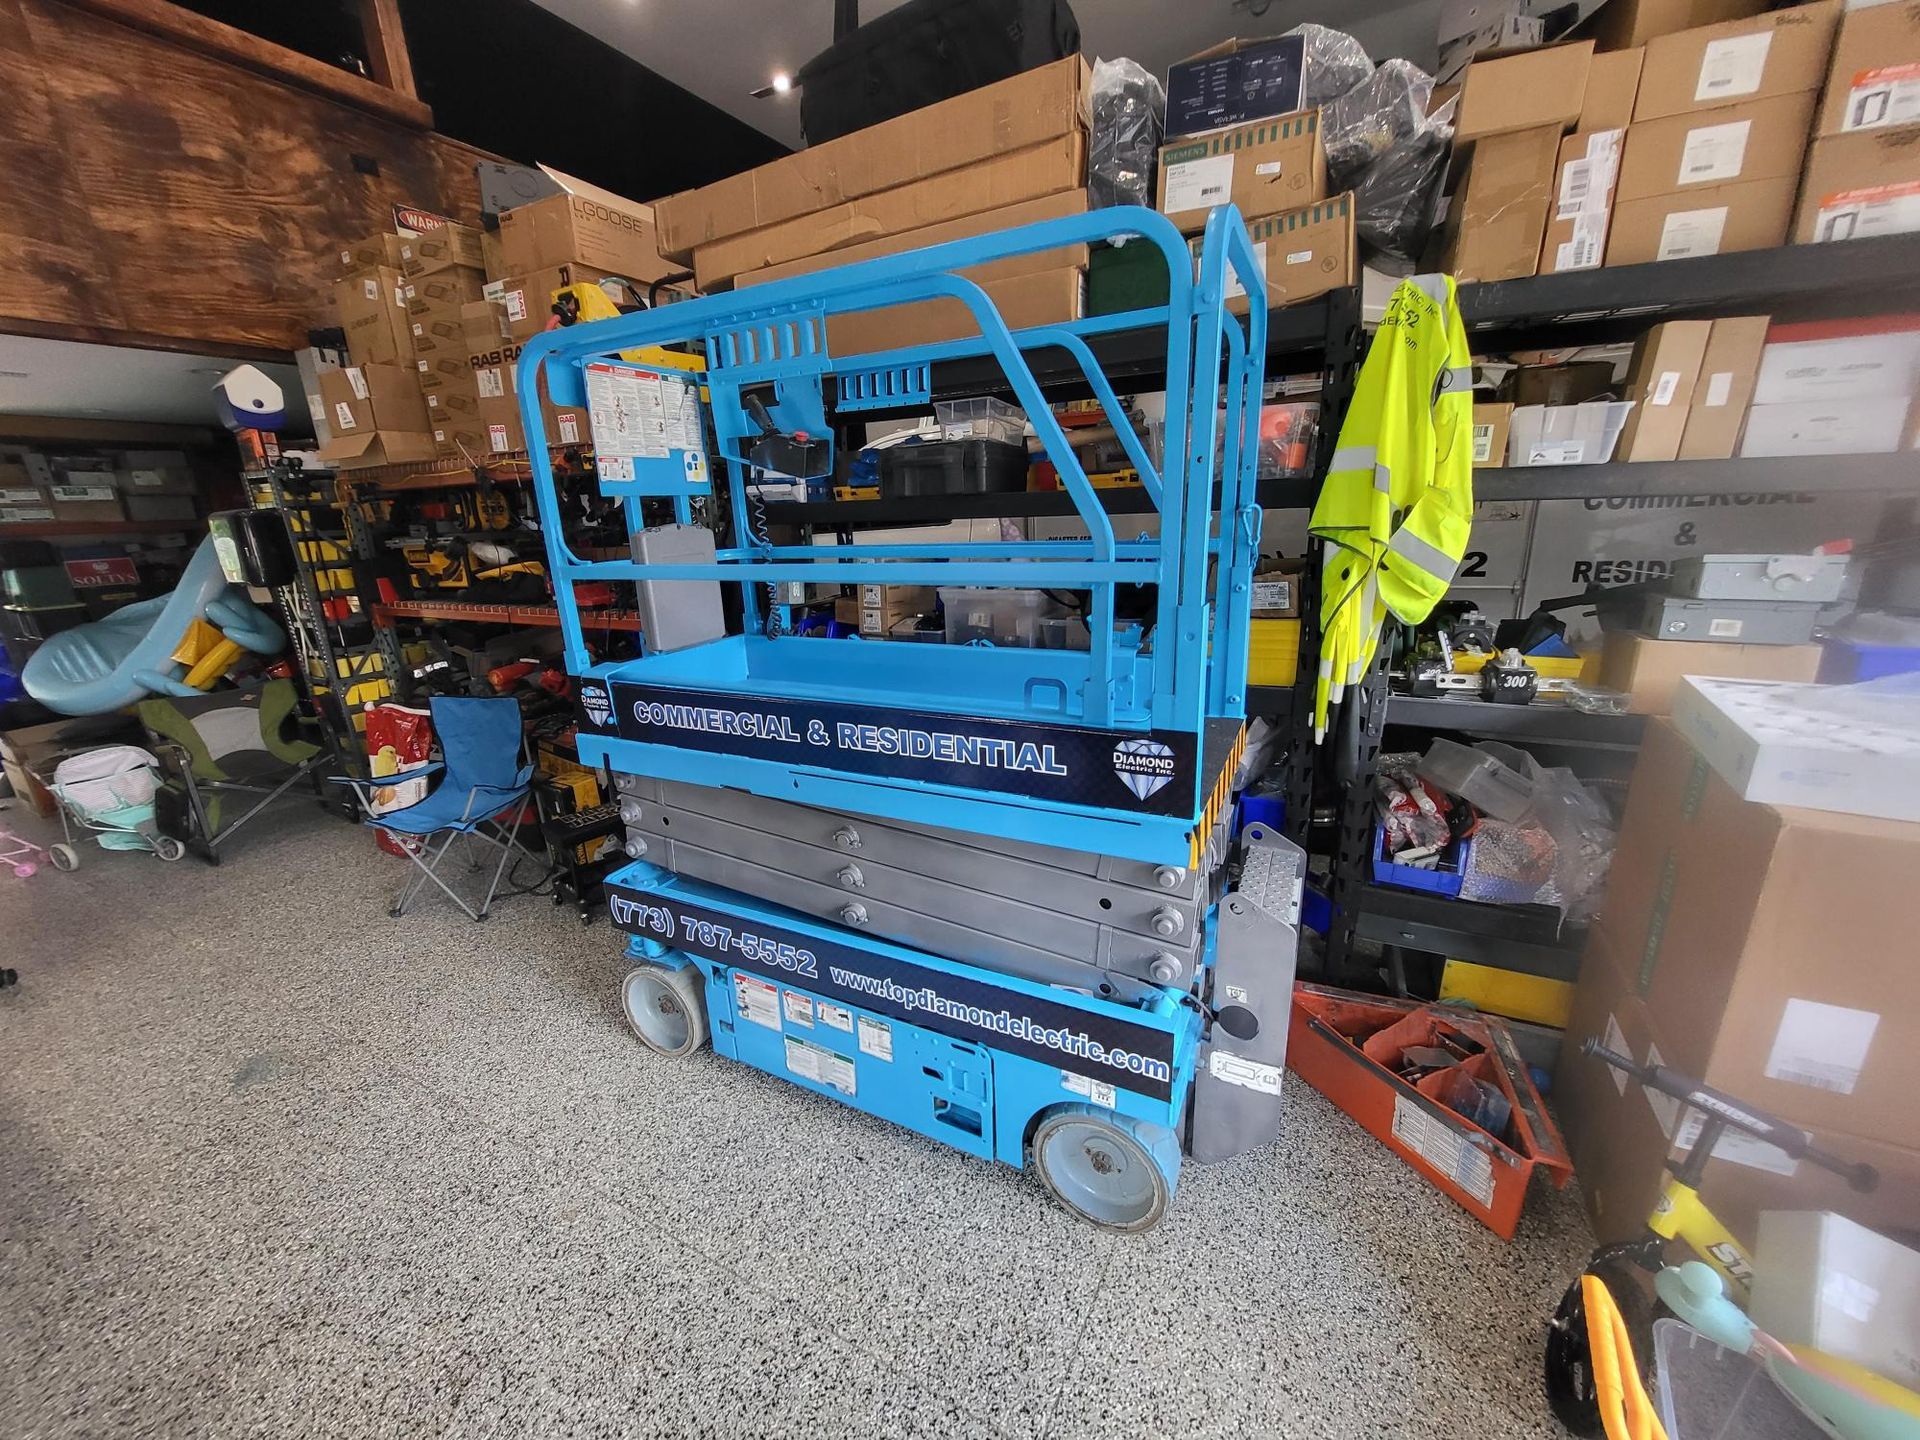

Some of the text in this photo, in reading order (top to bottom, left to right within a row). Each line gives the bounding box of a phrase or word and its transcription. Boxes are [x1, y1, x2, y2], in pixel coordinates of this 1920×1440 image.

[405, 212, 445, 231] WARN
[572, 198, 643, 234] LGOOSE
[470, 344, 526, 371] RAB RA
[490, 425, 506, 433] RAB
[559, 415, 576, 424] RAB
[1674, 521, 1697, 546] &
[1461, 551, 1488, 577] 2
[1572, 560, 1675, 584] RESID
[1503, 675, 1528, 688] 300
[633, 701, 1068, 776] COMMERCIAL & RESIDENTIAL
[1113, 752, 1174, 769] DIAMOND
[1115, 763, 1175, 776] Electric Inc.
[610, 895, 818, 979] (773) 787-5552
[829, 965, 1169, 1082] www.topdiamondelectric.com
